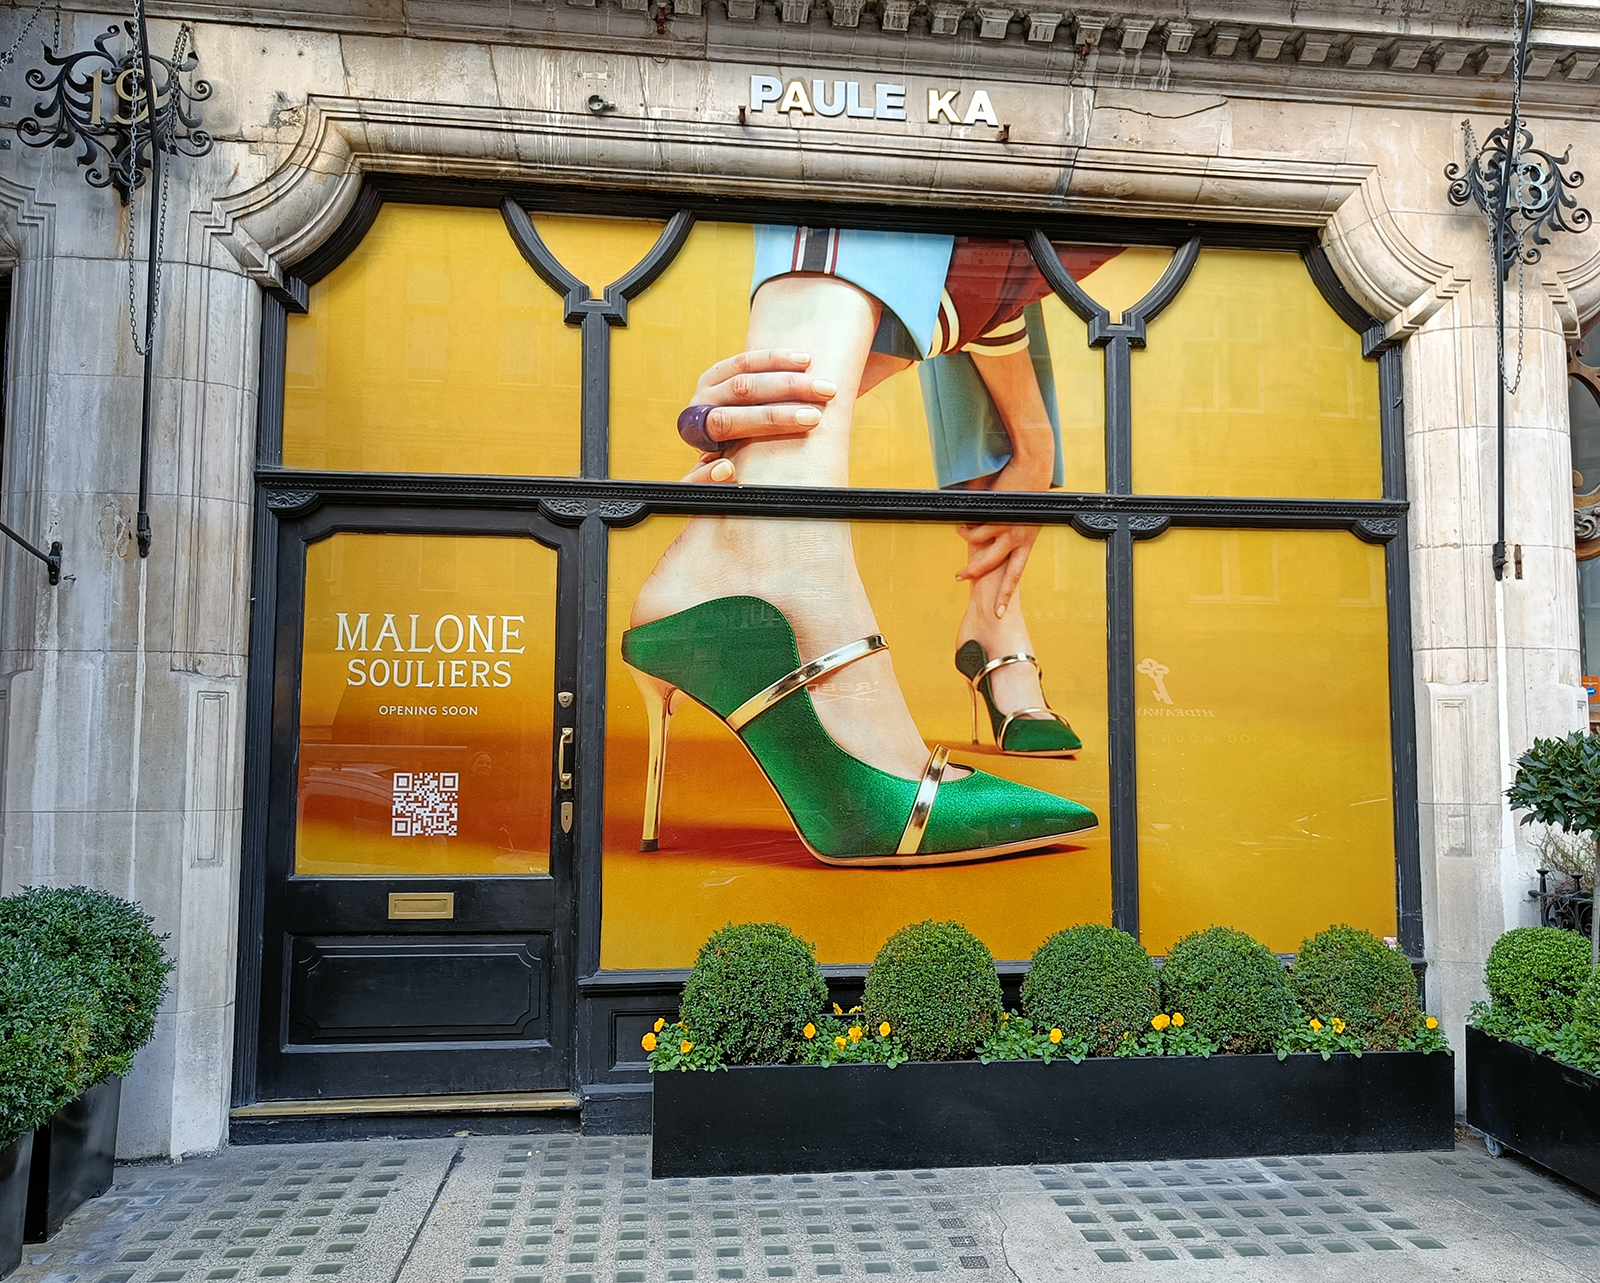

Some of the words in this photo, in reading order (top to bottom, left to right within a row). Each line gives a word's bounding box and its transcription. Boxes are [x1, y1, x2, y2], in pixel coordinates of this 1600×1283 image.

[90, 66, 157, 125] 19
[750, 75, 906, 120] PAULE
[927, 88, 999, 126] KA
[334, 612, 526, 654] MALONE
[347, 658, 512, 688] SOULIERS
[378, 705, 437, 717] OPENING
[441, 706, 478, 717] SOON
